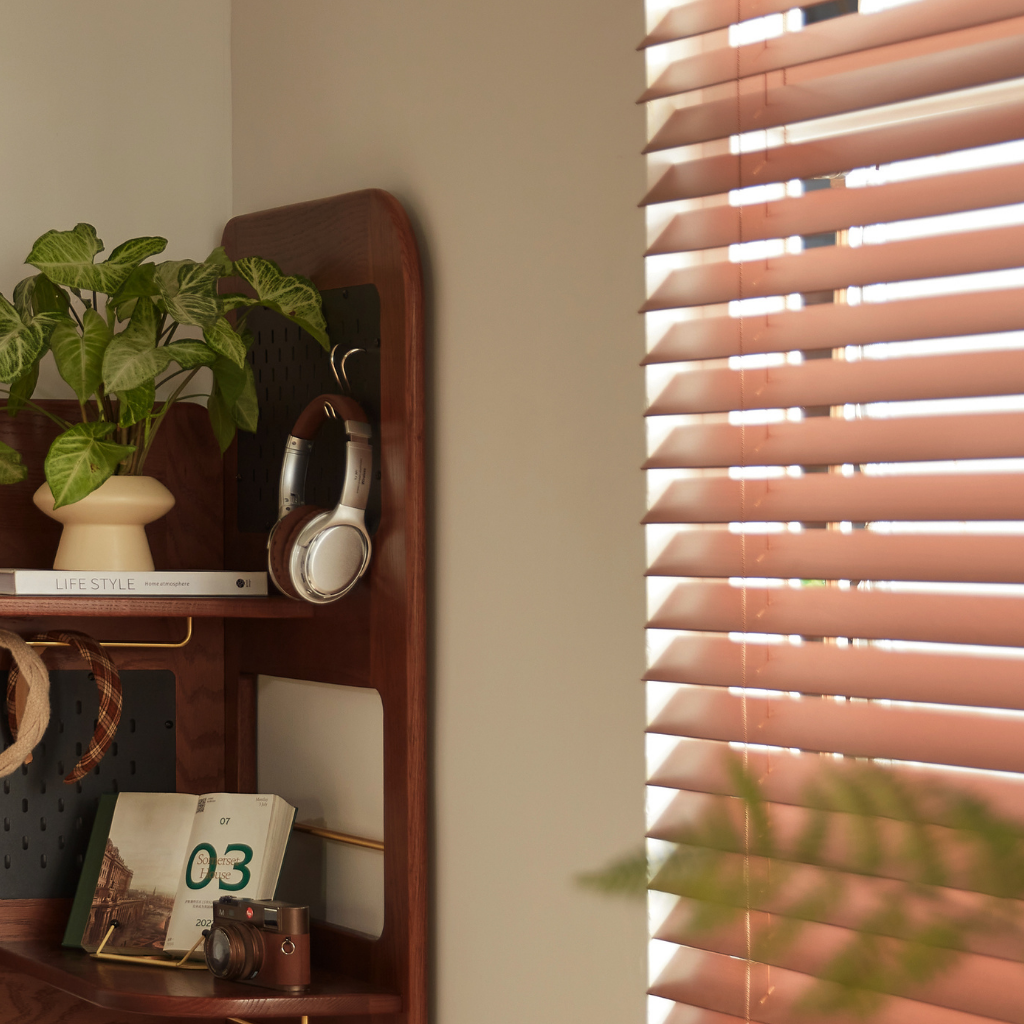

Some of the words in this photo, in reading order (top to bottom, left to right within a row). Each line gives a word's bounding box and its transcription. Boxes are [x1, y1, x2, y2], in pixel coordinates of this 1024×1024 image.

[55, 577, 86, 590] LIFE
[90, 577, 136, 591] STYLE
[219, 817, 231, 826] 07
[196, 853, 241, 866] Somerset
[185, 842, 254, 892] 03
[199, 867, 232, 880] House
[195, 918, 213, 927] 202
